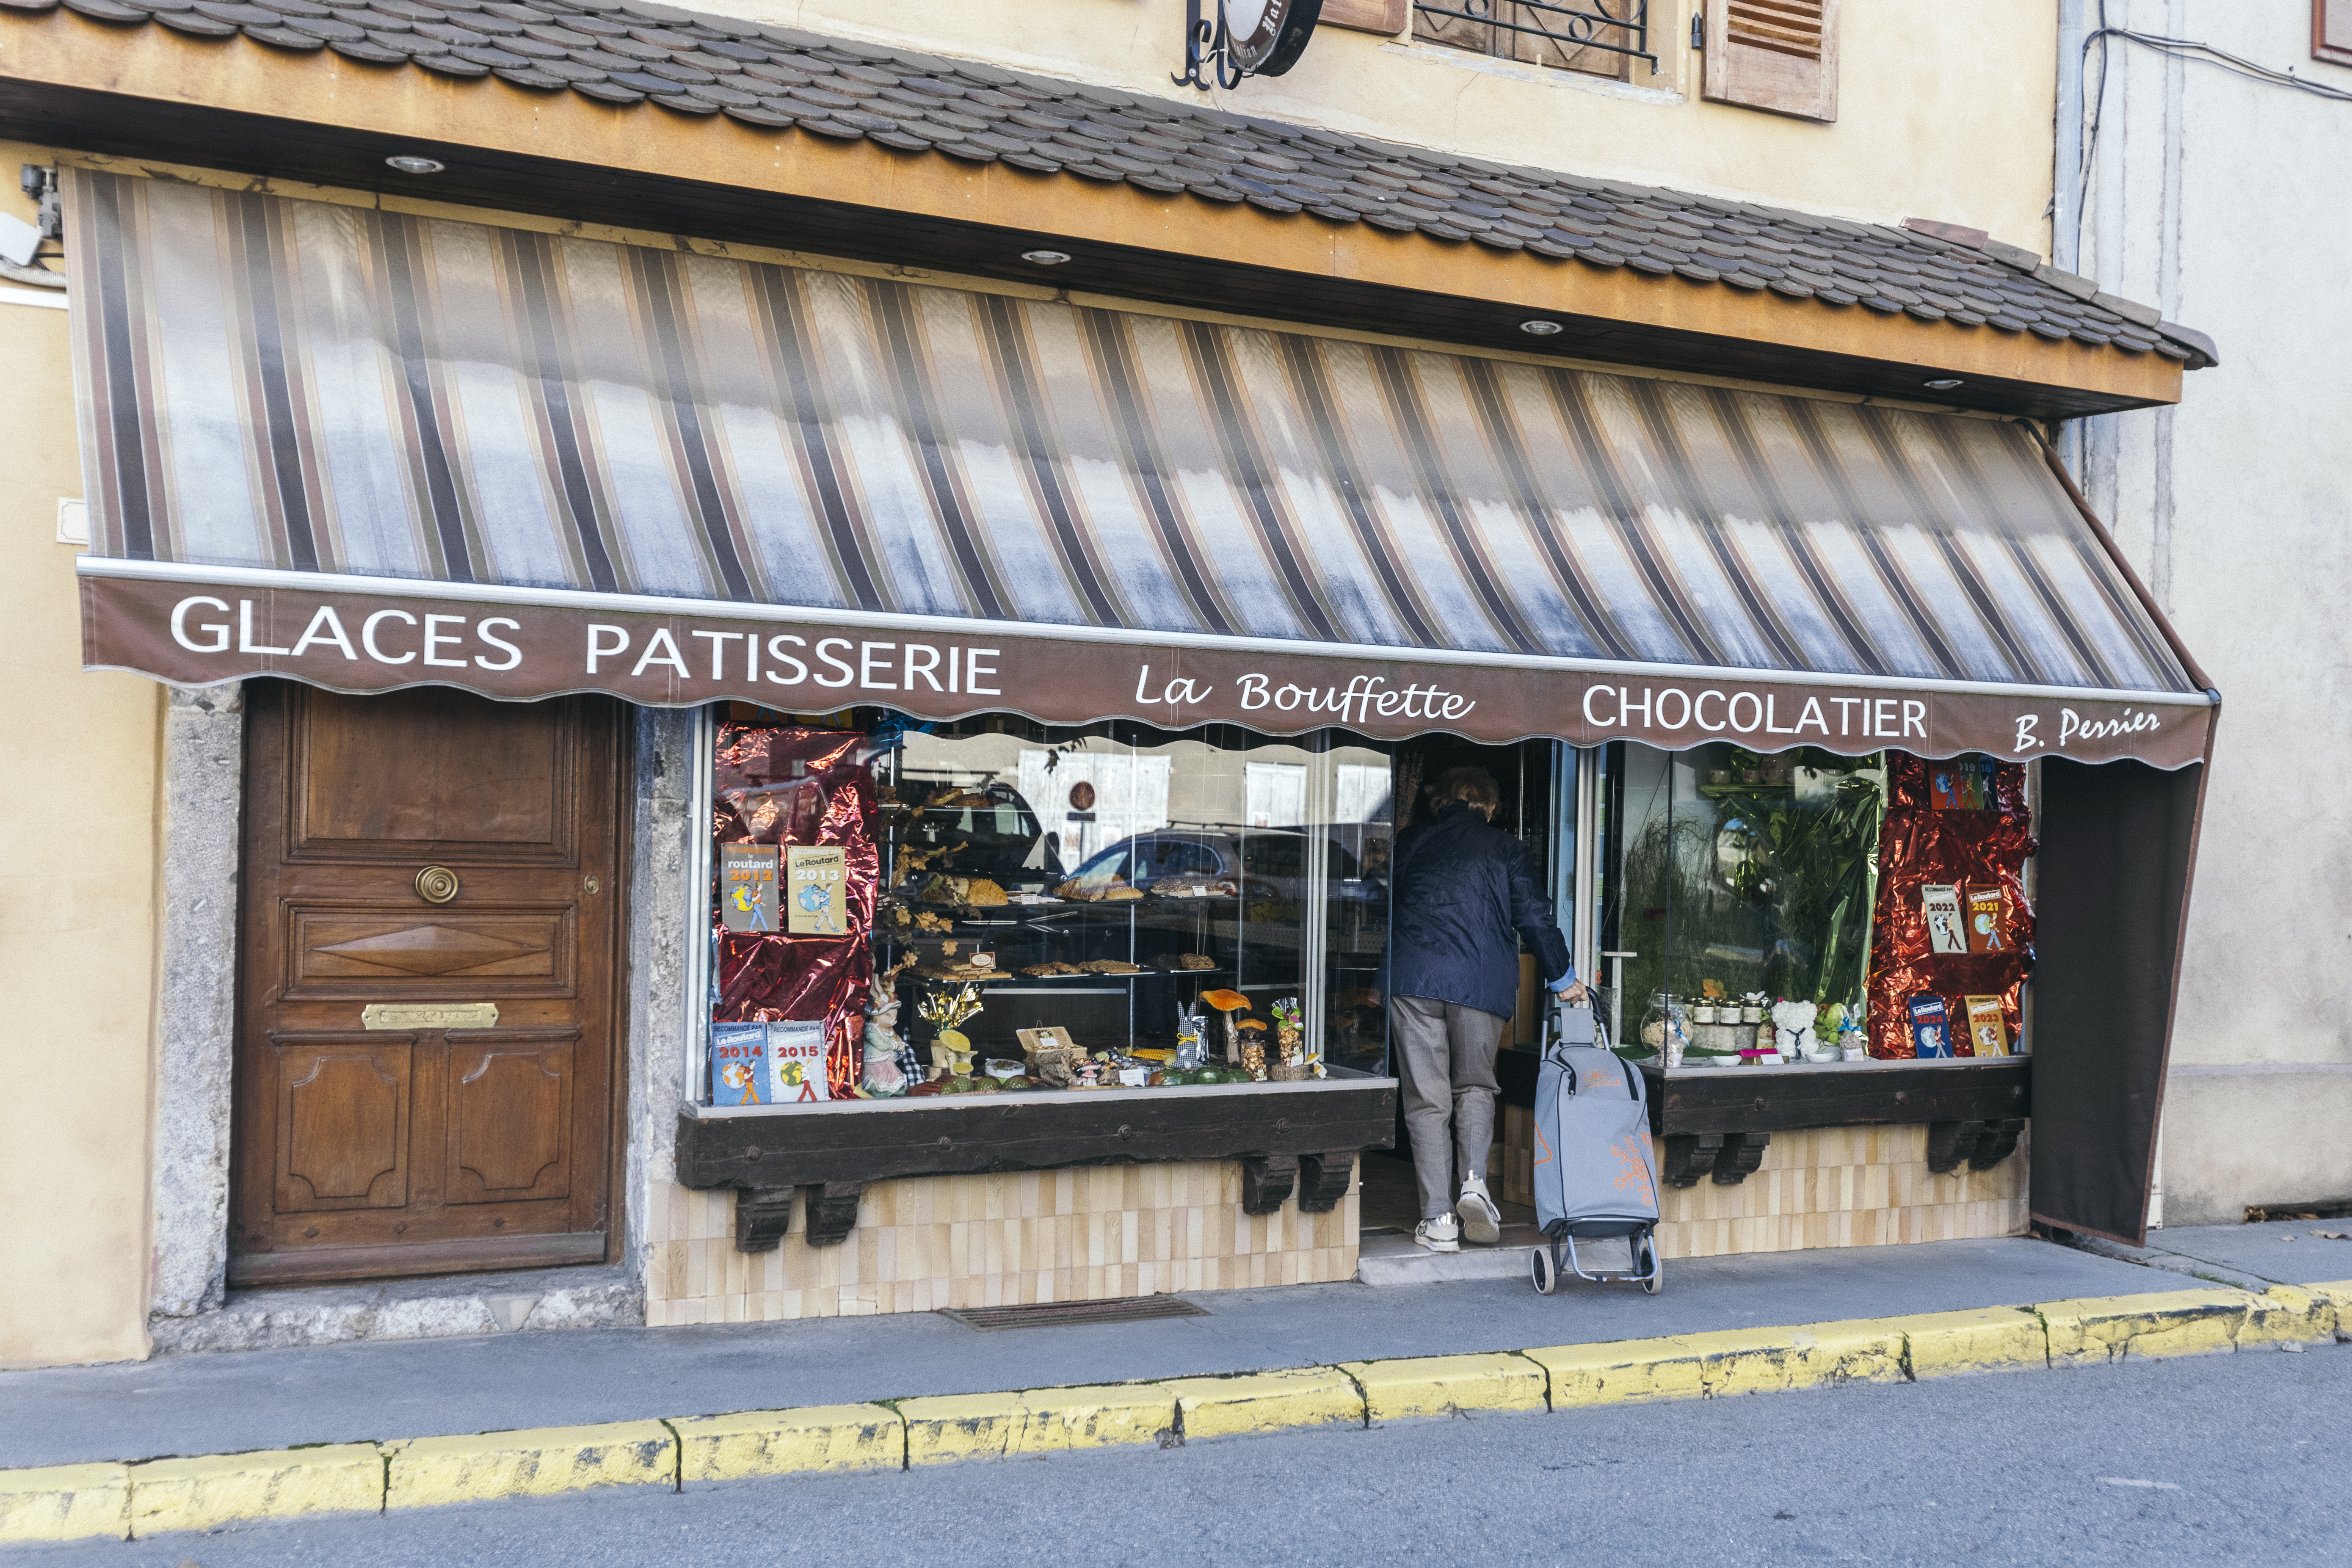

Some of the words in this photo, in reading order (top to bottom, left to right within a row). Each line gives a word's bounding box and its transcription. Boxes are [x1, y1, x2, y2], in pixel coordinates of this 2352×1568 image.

[170, 595, 523, 671] GLACES
[586, 624, 1002, 696] PATISSERIE
[1135, 665, 1212, 704] La
[1236, 673, 1477, 723] Bouffette
[1582, 684, 1927, 738] CHOCOLATIER
[2013, 713, 2045, 753] B.
[728, 859, 773, 869] routard
[729, 869, 773, 881] 2012
[796, 869, 839, 881] 2013
[1929, 903, 1955, 911] 2022
[1972, 902, 1999, 911] 2021
[1916, 1015, 1943, 1024] 2024
[1973, 1013, 1999, 1022] 2023
[719, 1046, 762, 1058] 2014
[778, 1046, 818, 1057] 2015
